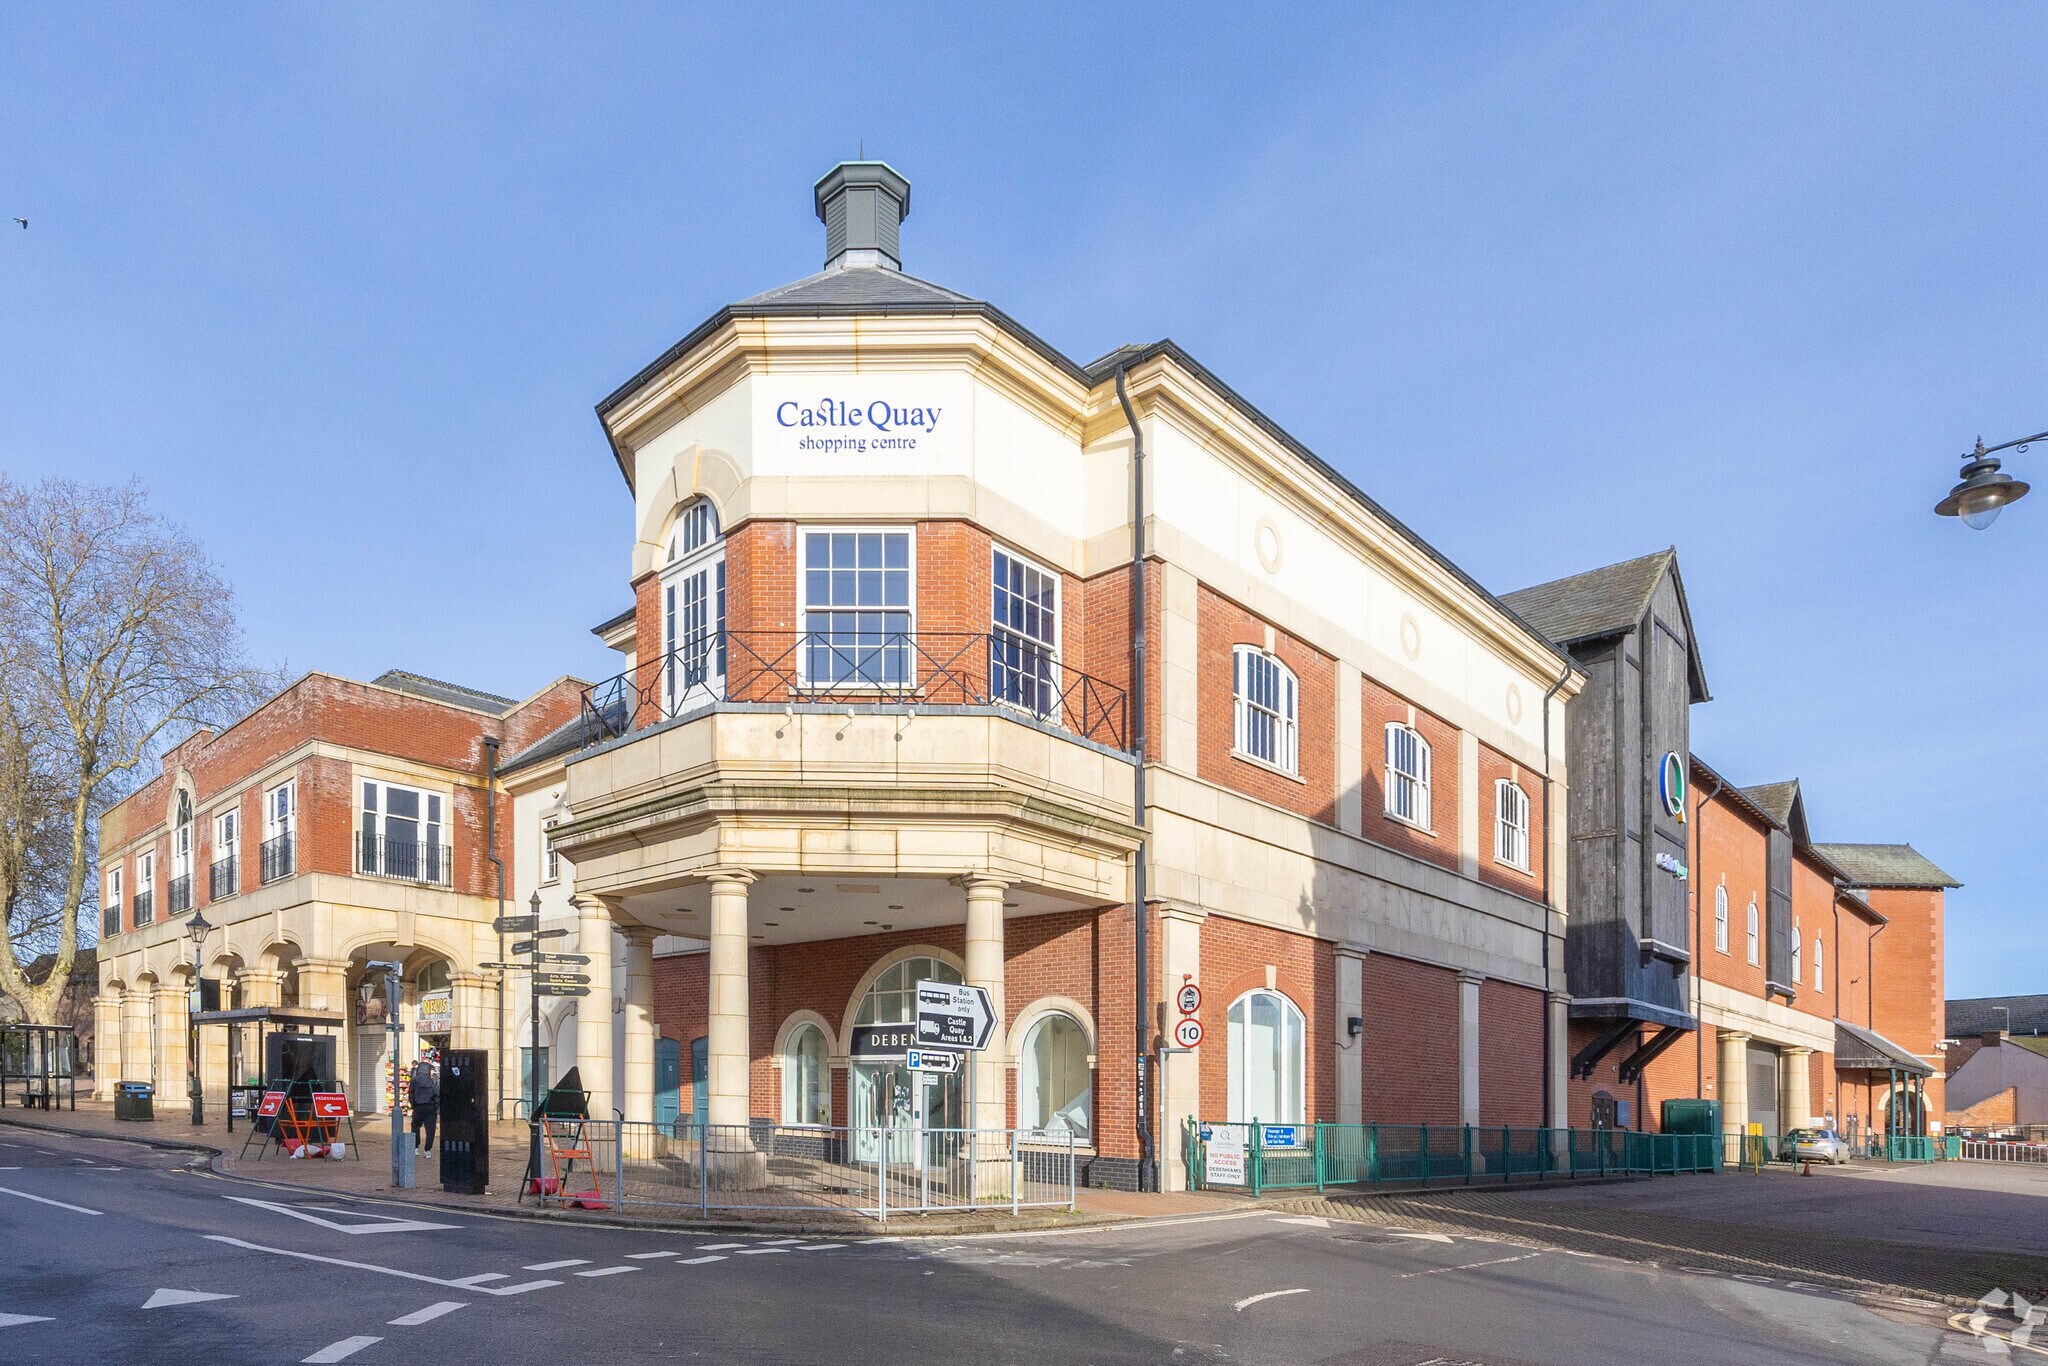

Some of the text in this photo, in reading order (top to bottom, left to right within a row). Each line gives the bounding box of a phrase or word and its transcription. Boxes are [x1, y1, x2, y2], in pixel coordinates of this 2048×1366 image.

[777, 398, 942, 433] Castle Quay
[799, 435, 917, 453] shopping centre
[958, 988, 970, 996] Bus
[952, 996, 974, 1005] Station
[422, 998, 448, 1015] NEWS
[957, 1005, 970, 1013] only
[947, 1017, 967, 1026] Castle
[949, 1025, 965, 1035] Quay
[1181, 1027, 1199, 1040] 10
[871, 1033, 918, 1046] DEBEN
[941, 1033, 958, 1042] Areas
[911, 1053, 919, 1066] P
